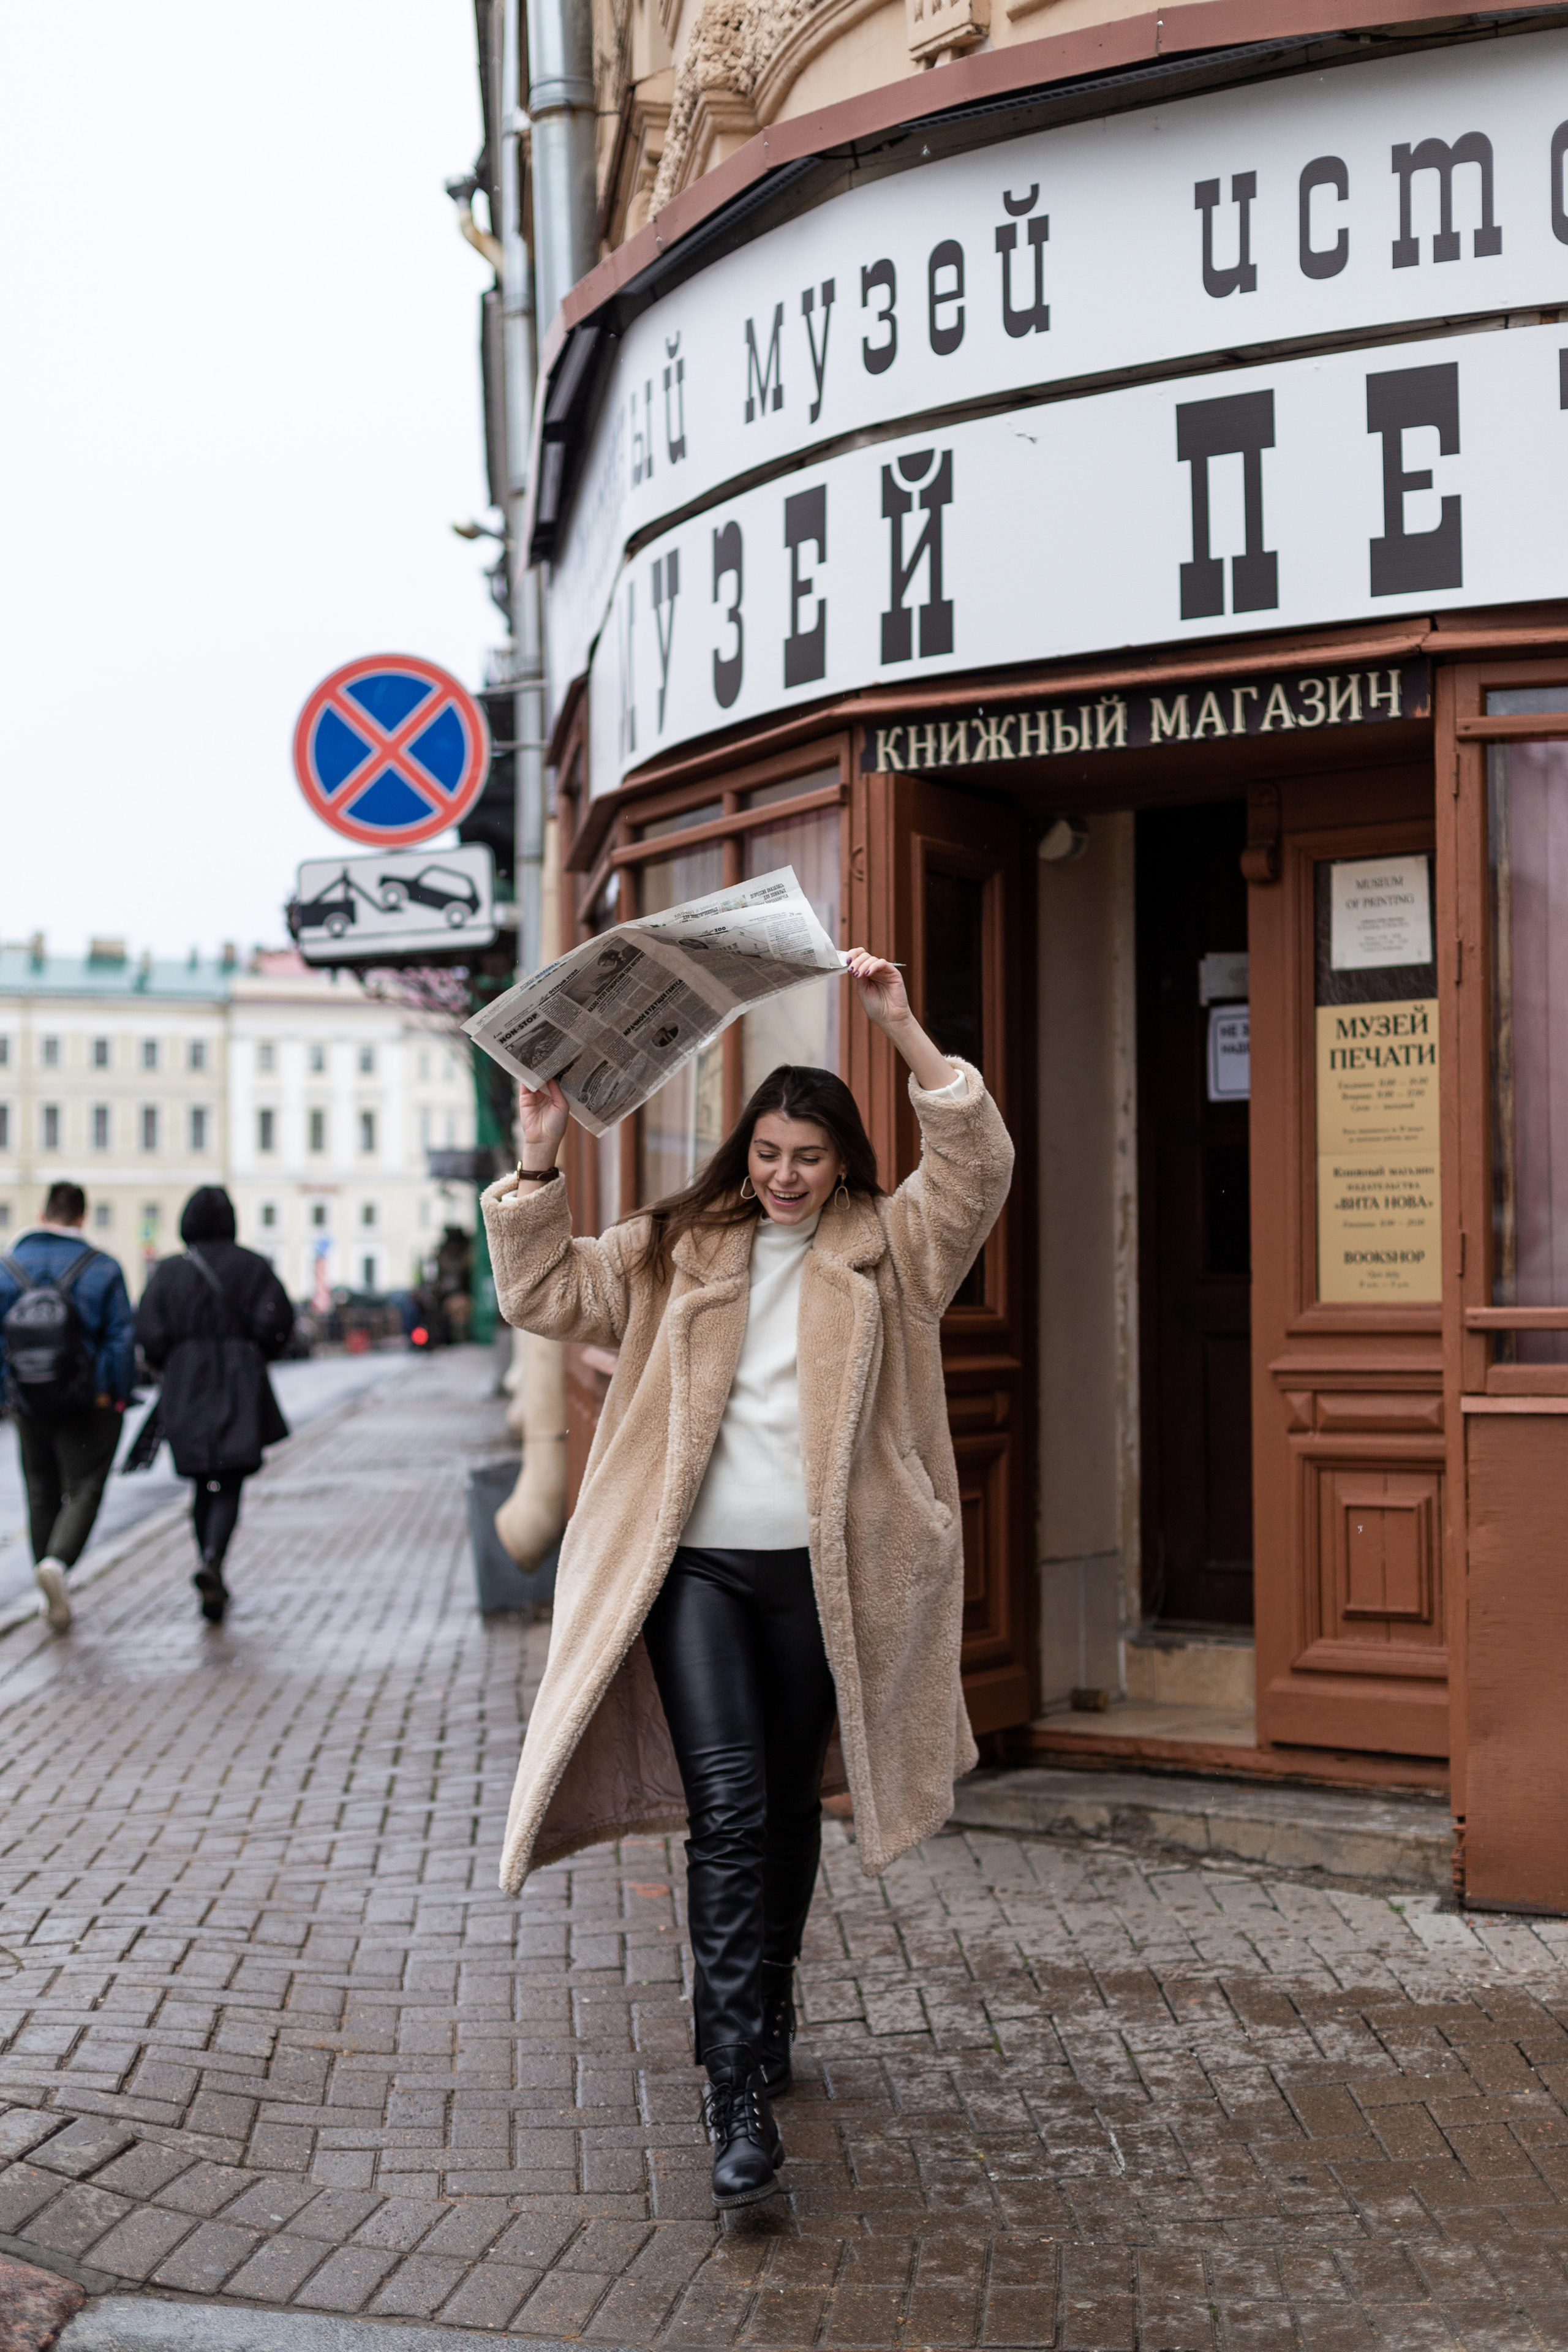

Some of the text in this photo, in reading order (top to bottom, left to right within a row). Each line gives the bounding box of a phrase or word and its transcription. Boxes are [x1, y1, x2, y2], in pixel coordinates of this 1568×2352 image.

[743, 183, 1050, 424] музей
[1176, 347, 1568, 620] ПЕ
[875, 669, 1403, 773] КНИЖНЫЙ МАГАЗИН
[1355, 875, 1404, 889] MUSEUM
[1345, 892, 1415, 909] OF PRINTING
[622, 1012, 646, 1036] МРАЧНОЕ
[643, 992, 668, 1016] БУДУЩЕЕ
[665, 978, 683, 995] ГЕЙТСА
[1336, 1004, 1428, 1040] МУЗЕЙ
[498, 1011, 539, 1044] NON-STOP
[1330, 1043, 1436, 1071] ПЕЧАТИ
[1344, 1250, 1425, 1265] BOOKSHOP
